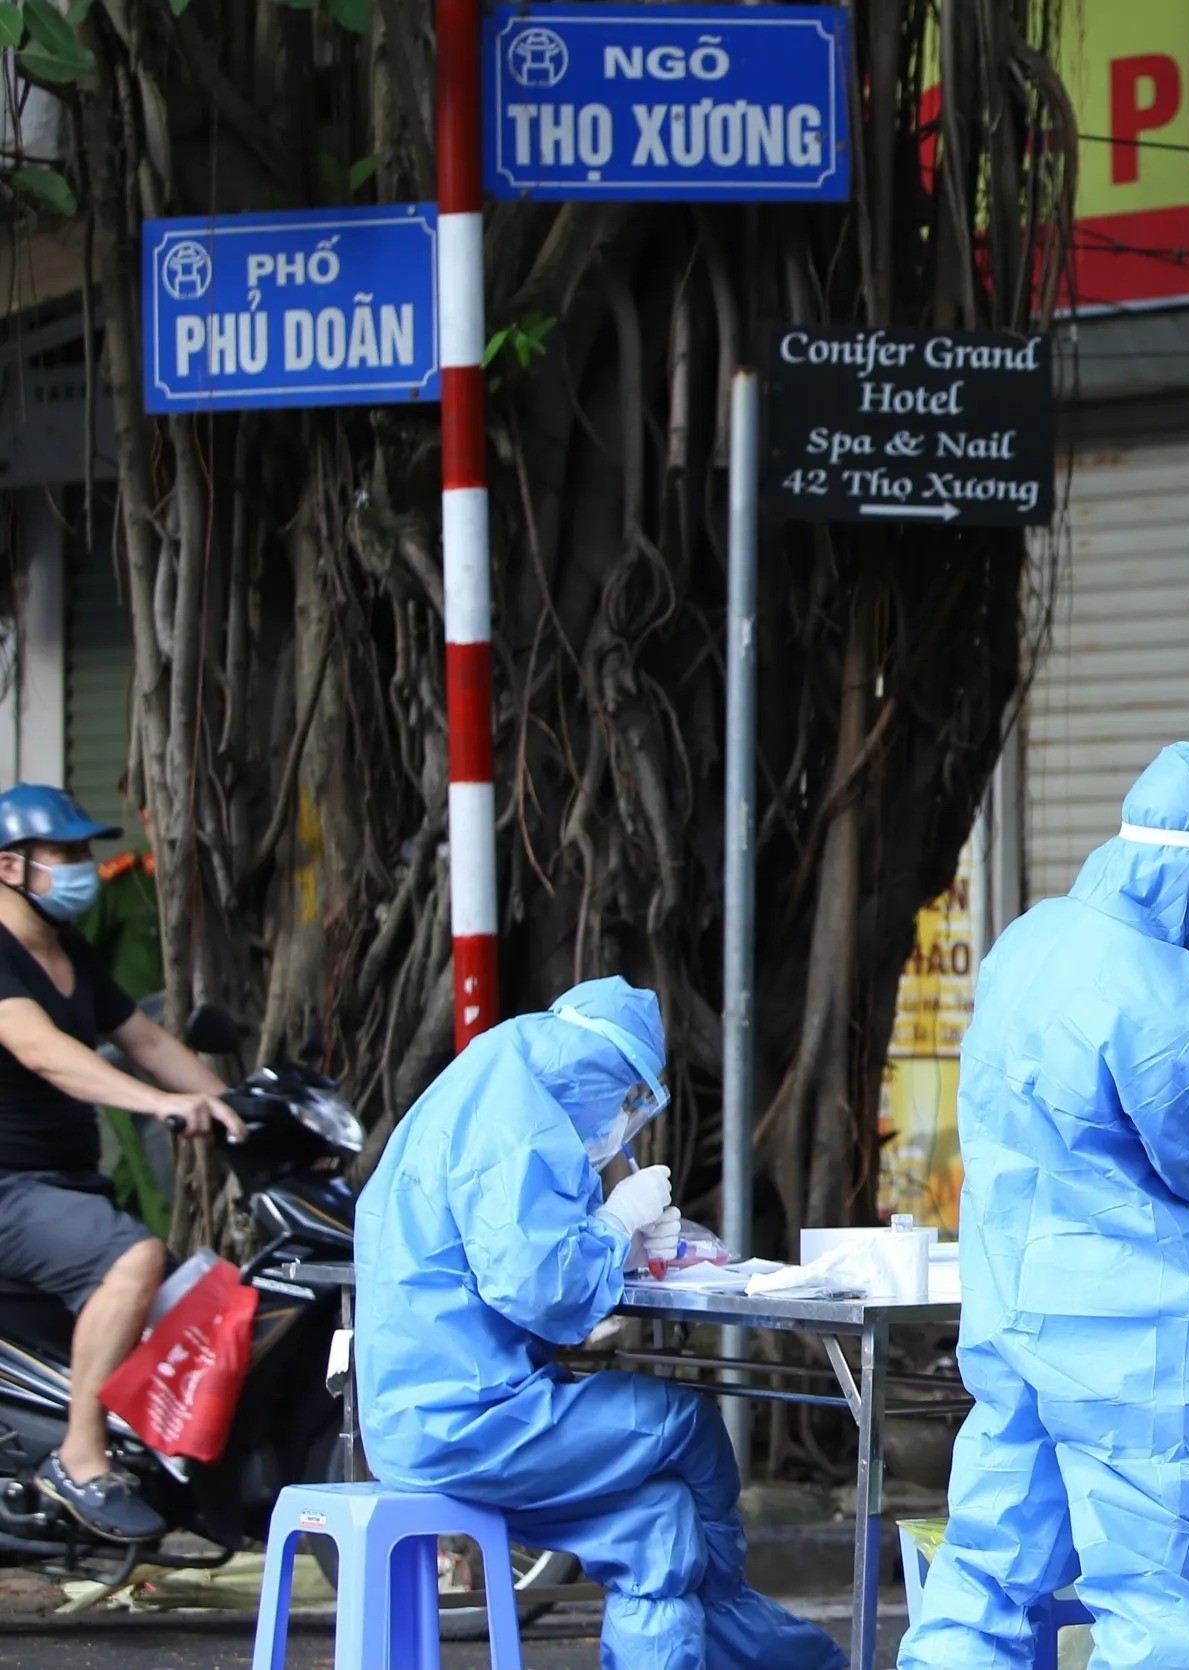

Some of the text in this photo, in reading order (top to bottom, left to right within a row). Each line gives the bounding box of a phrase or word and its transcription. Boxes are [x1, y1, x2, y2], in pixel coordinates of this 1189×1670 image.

[604, 35, 730, 80] NGÕ
[507, 98, 822, 181] THỌ XƯƠNG
[247, 234, 341, 288] PHỐ
[175, 289, 414, 377] PHỦ DOÃN
[780, 331, 1041, 378] Conifer Grand
[858, 381, 965, 415] Hotel
[806, 427, 1016, 464] Spa & Nail
[782, 468, 830, 496] 42
